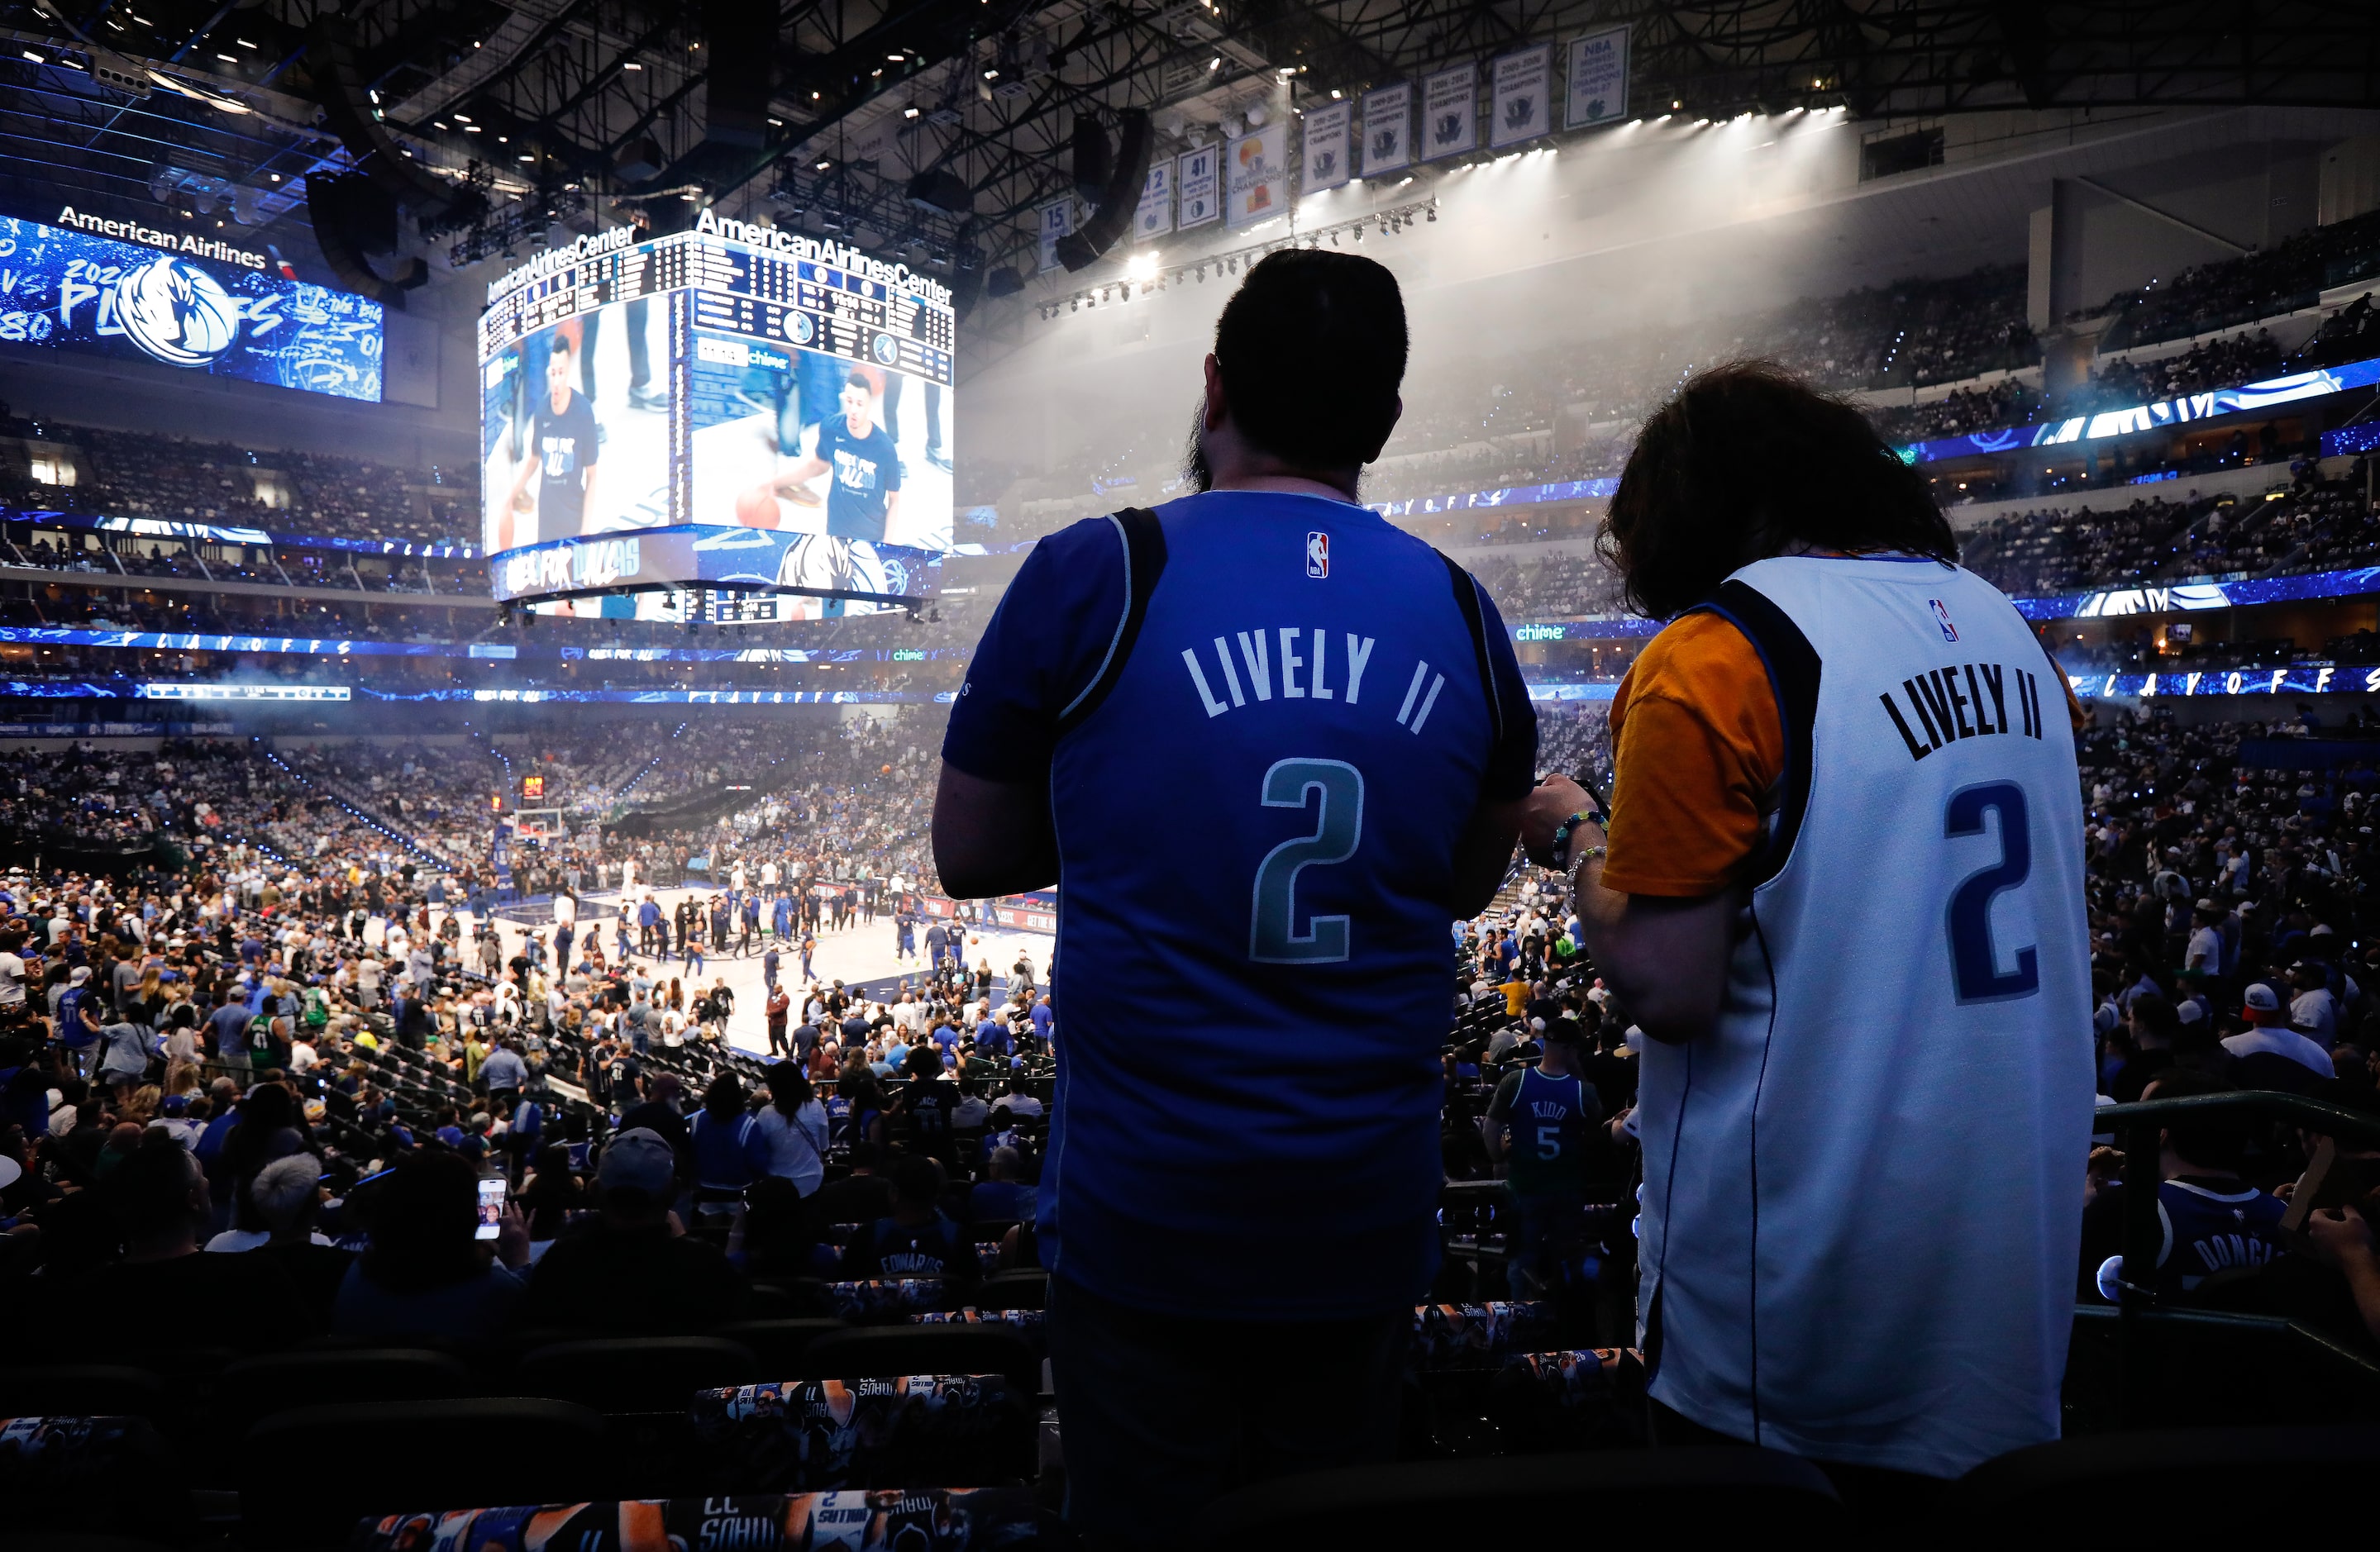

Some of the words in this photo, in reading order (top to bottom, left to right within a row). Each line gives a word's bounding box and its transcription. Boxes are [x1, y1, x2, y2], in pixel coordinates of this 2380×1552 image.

[1585, 39, 1612, 56] NBA
[1499, 75, 1543, 95] CHAMPIONS
[1573, 69, 1621, 89] CHAMPIONS
[1428, 93, 1469, 111] CHAMPIONS
[1366, 111, 1405, 128] CHAMPIONS
[1191, 156, 1206, 177] 41
[1232, 170, 1283, 196] CHAMPIONS
[1047, 207, 1064, 229] 15
[57, 206, 178, 250] American
[179, 233, 266, 270] Airlines
[748, 350, 789, 370] chime
[1309, 566, 1322, 576] NBA
[1515, 623, 1566, 641] chime
[122, 631, 351, 655] PLAYOFFS
[894, 649, 924, 661] chime
[1181, 628, 1384, 718] LIVELY
[1396, 659, 1454, 736] II
[688, 691, 843, 703] PLAYOFFS
[1879, 663, 2008, 762] LIVELY
[2015, 668, 2042, 740] II
[1248, 757, 1365, 964] 2
[1944, 778, 2039, 1007] 2
[1531, 1100, 1567, 1121] KIDD
[1537, 1126, 1561, 1161] 5
[2192, 1231, 2287, 1273] DONČI
[880, 1252, 945, 1275] EDWARDS
[805, 1385, 817, 1402] 11
[858, 1382, 893, 1397] MAVS
[804, 1403, 829, 1419] AVS
[703, 1496, 741, 1515] 77
[818, 1507, 868, 1524] DALLAS
[699, 1515, 776, 1550] MAVS
